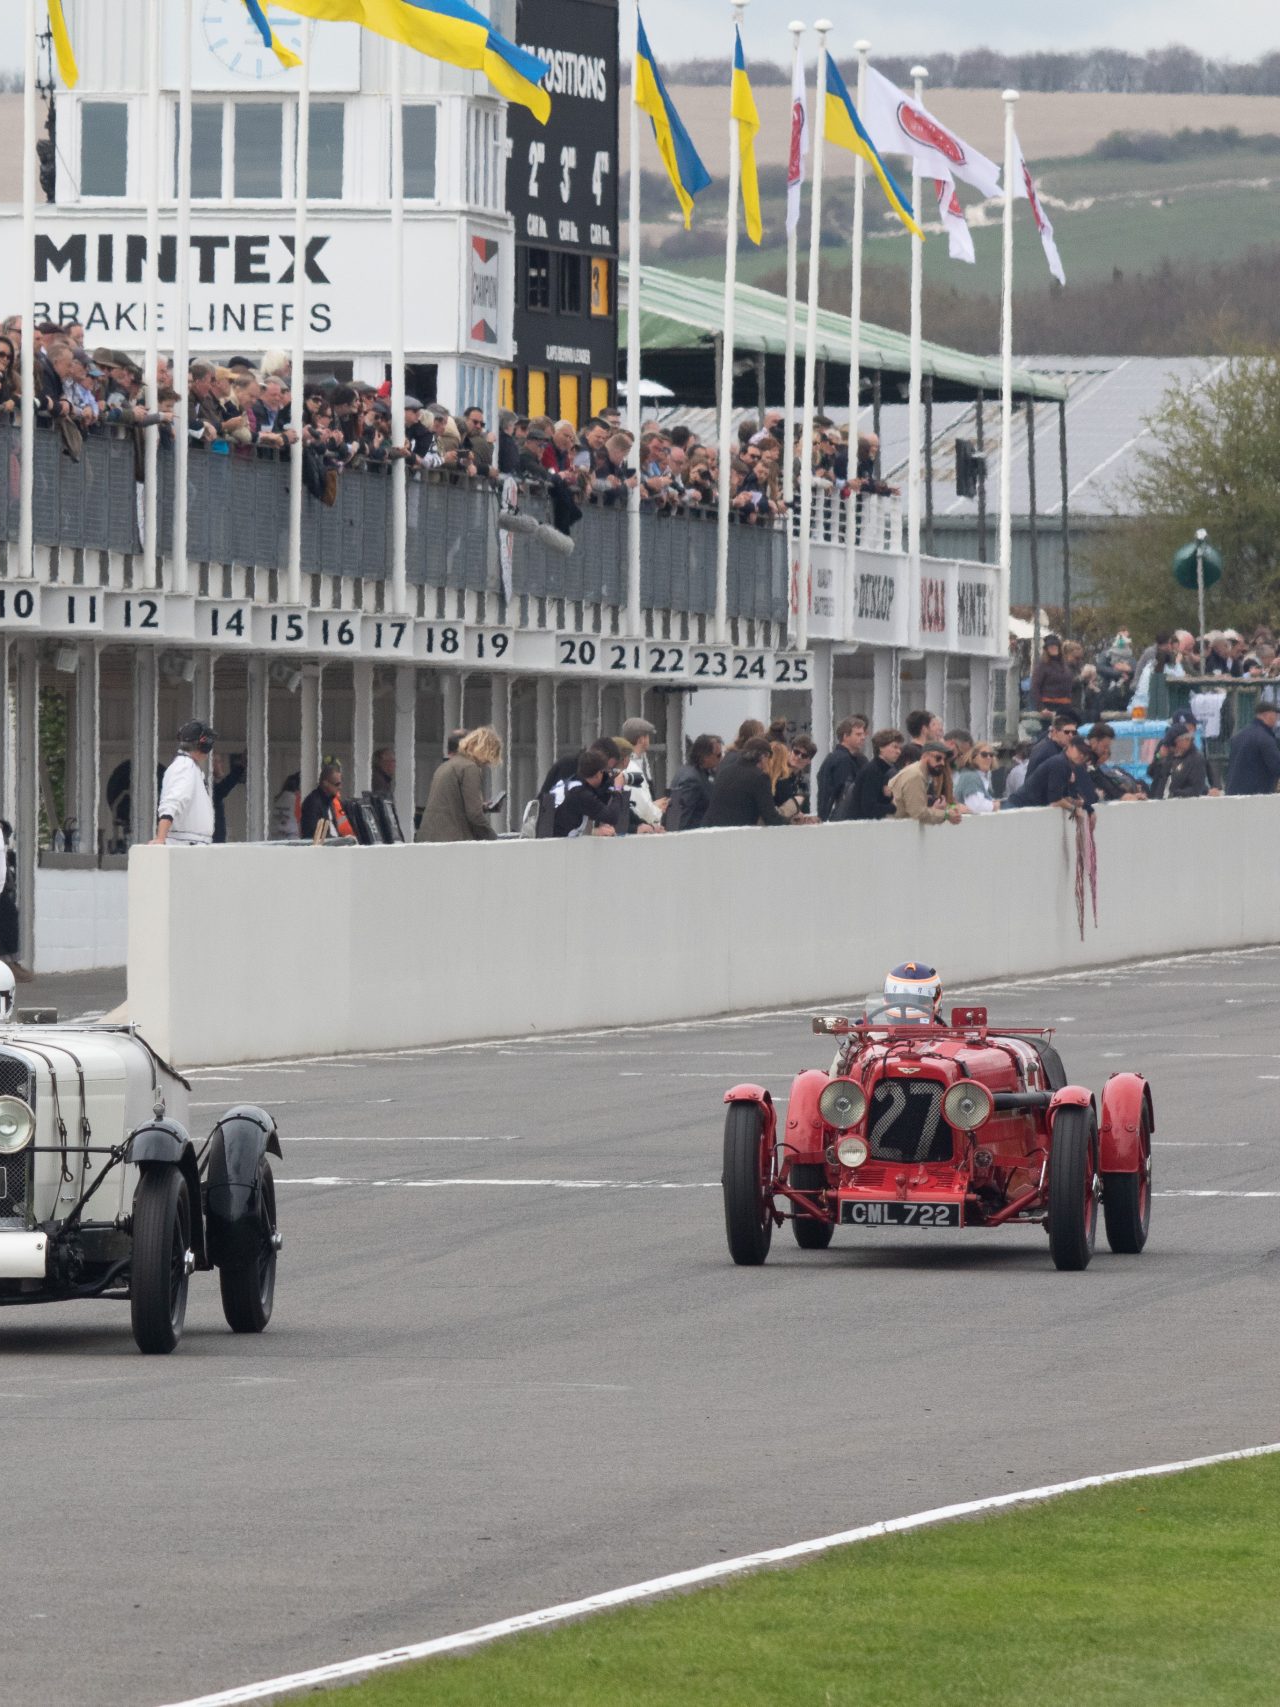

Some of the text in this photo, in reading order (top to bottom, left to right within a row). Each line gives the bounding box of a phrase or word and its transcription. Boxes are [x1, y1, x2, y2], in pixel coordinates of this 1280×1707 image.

[34, 234, 331, 283] MINTEX
[67, 595, 96, 624] 11
[124, 599, 159, 628] 12
[211, 608, 245, 637] 14
[270, 614, 304, 642] 15
[321, 619, 355, 646] 16
[374, 622, 407, 649] 17
[426, 627, 459, 654] 18
[477, 632, 509, 658] 19
[560, 639, 596, 665] 20
[610, 644, 640, 670] 21
[649, 647, 684, 673] 22
[694, 652, 727, 676] 23
[733, 654, 766, 679] 24
[775, 658, 808, 683] 25
[870, 1081, 945, 1161] 27
[852, 1203, 950, 1225] CML 722
